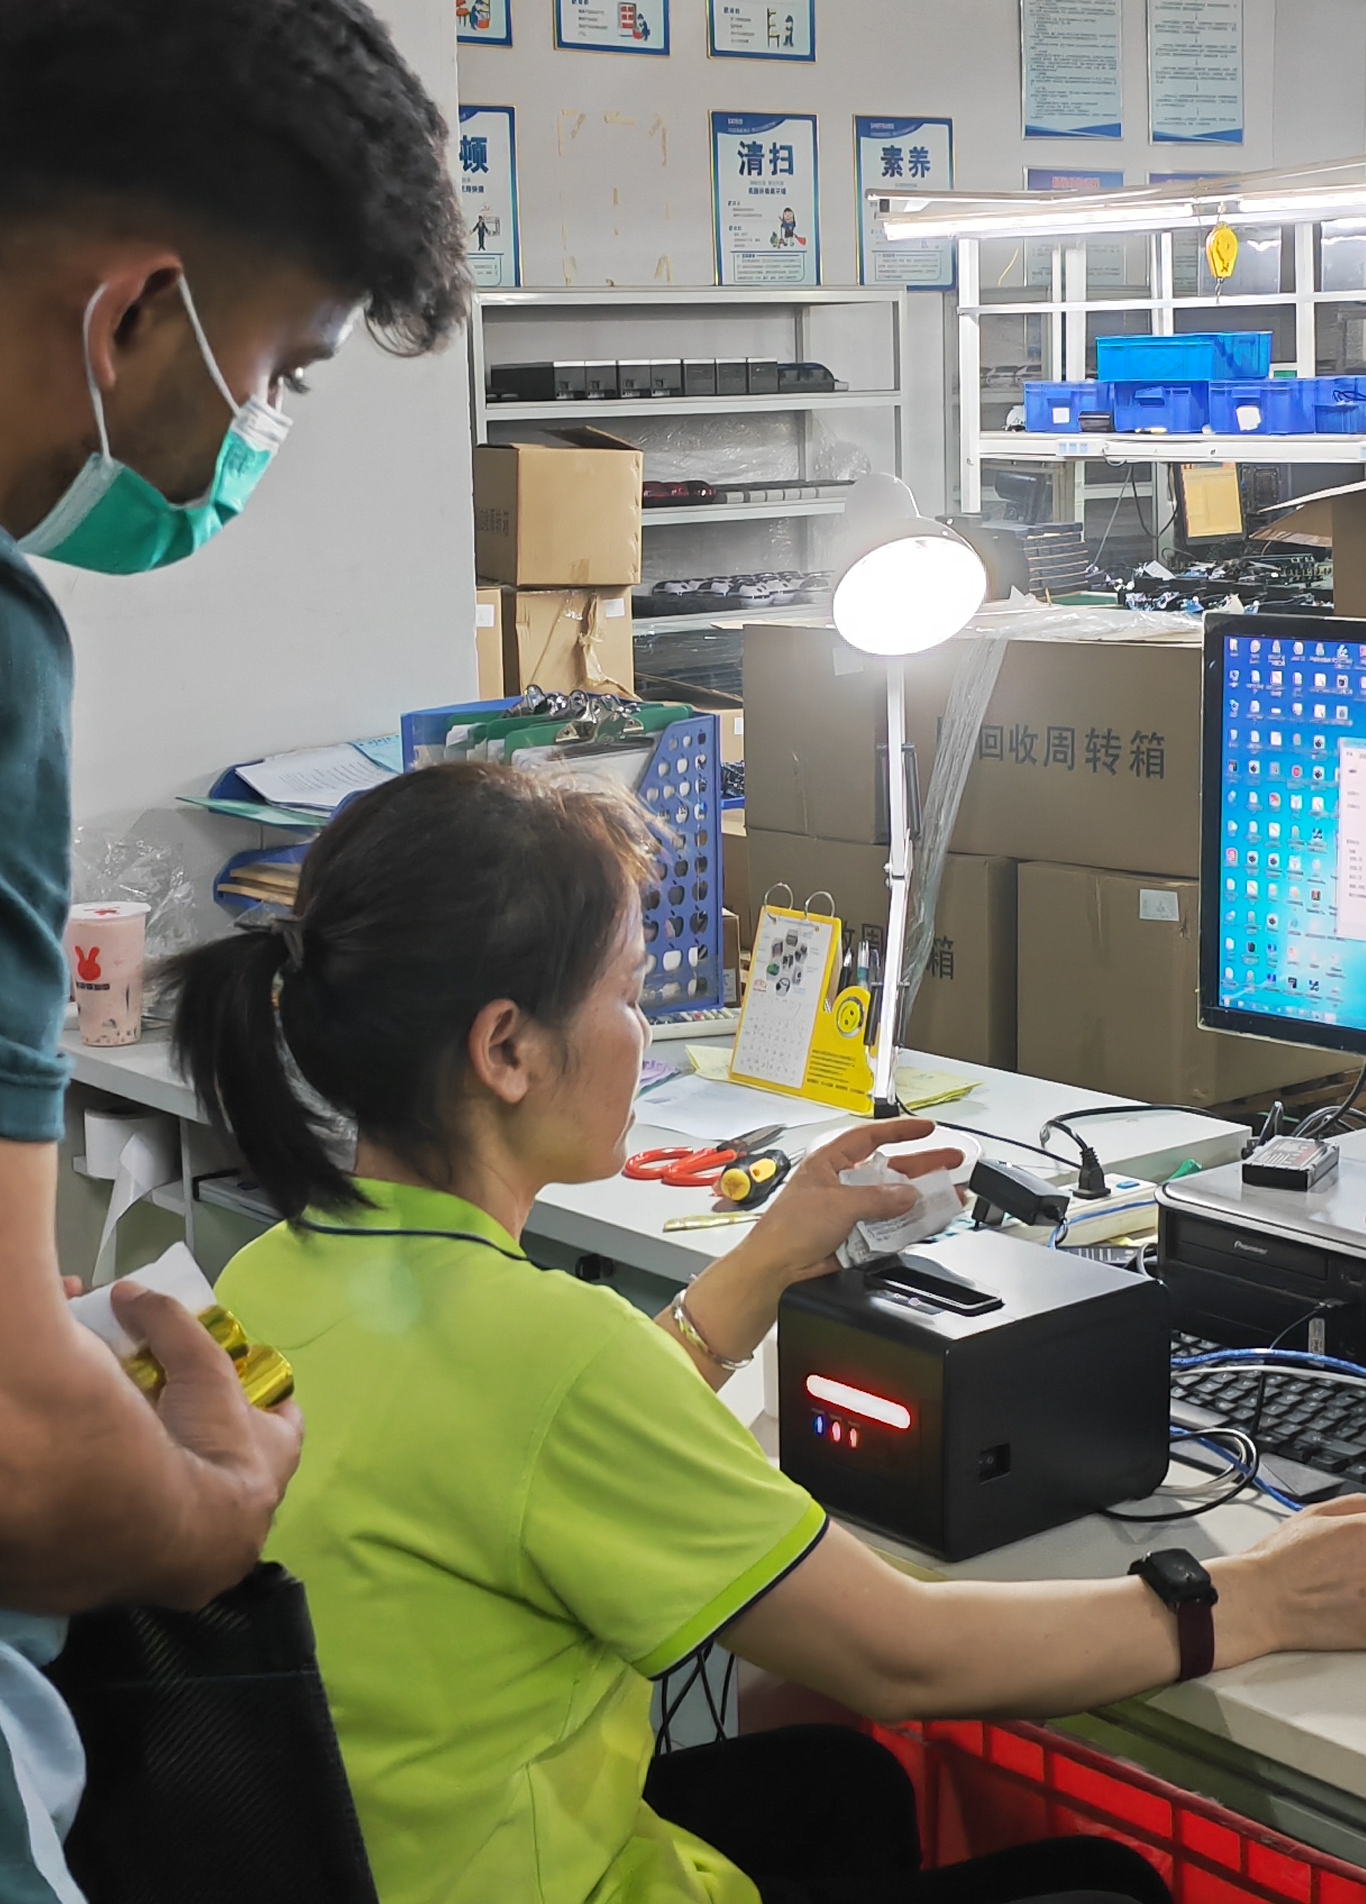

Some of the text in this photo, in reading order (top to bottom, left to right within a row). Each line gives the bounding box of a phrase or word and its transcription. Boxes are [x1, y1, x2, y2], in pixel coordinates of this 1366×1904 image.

[459, 135, 489, 174] 顿
[737, 141, 794, 177] 清扫
[880, 144, 931, 178] 素养
[937, 716, 1166, 780] 回收周转箱
